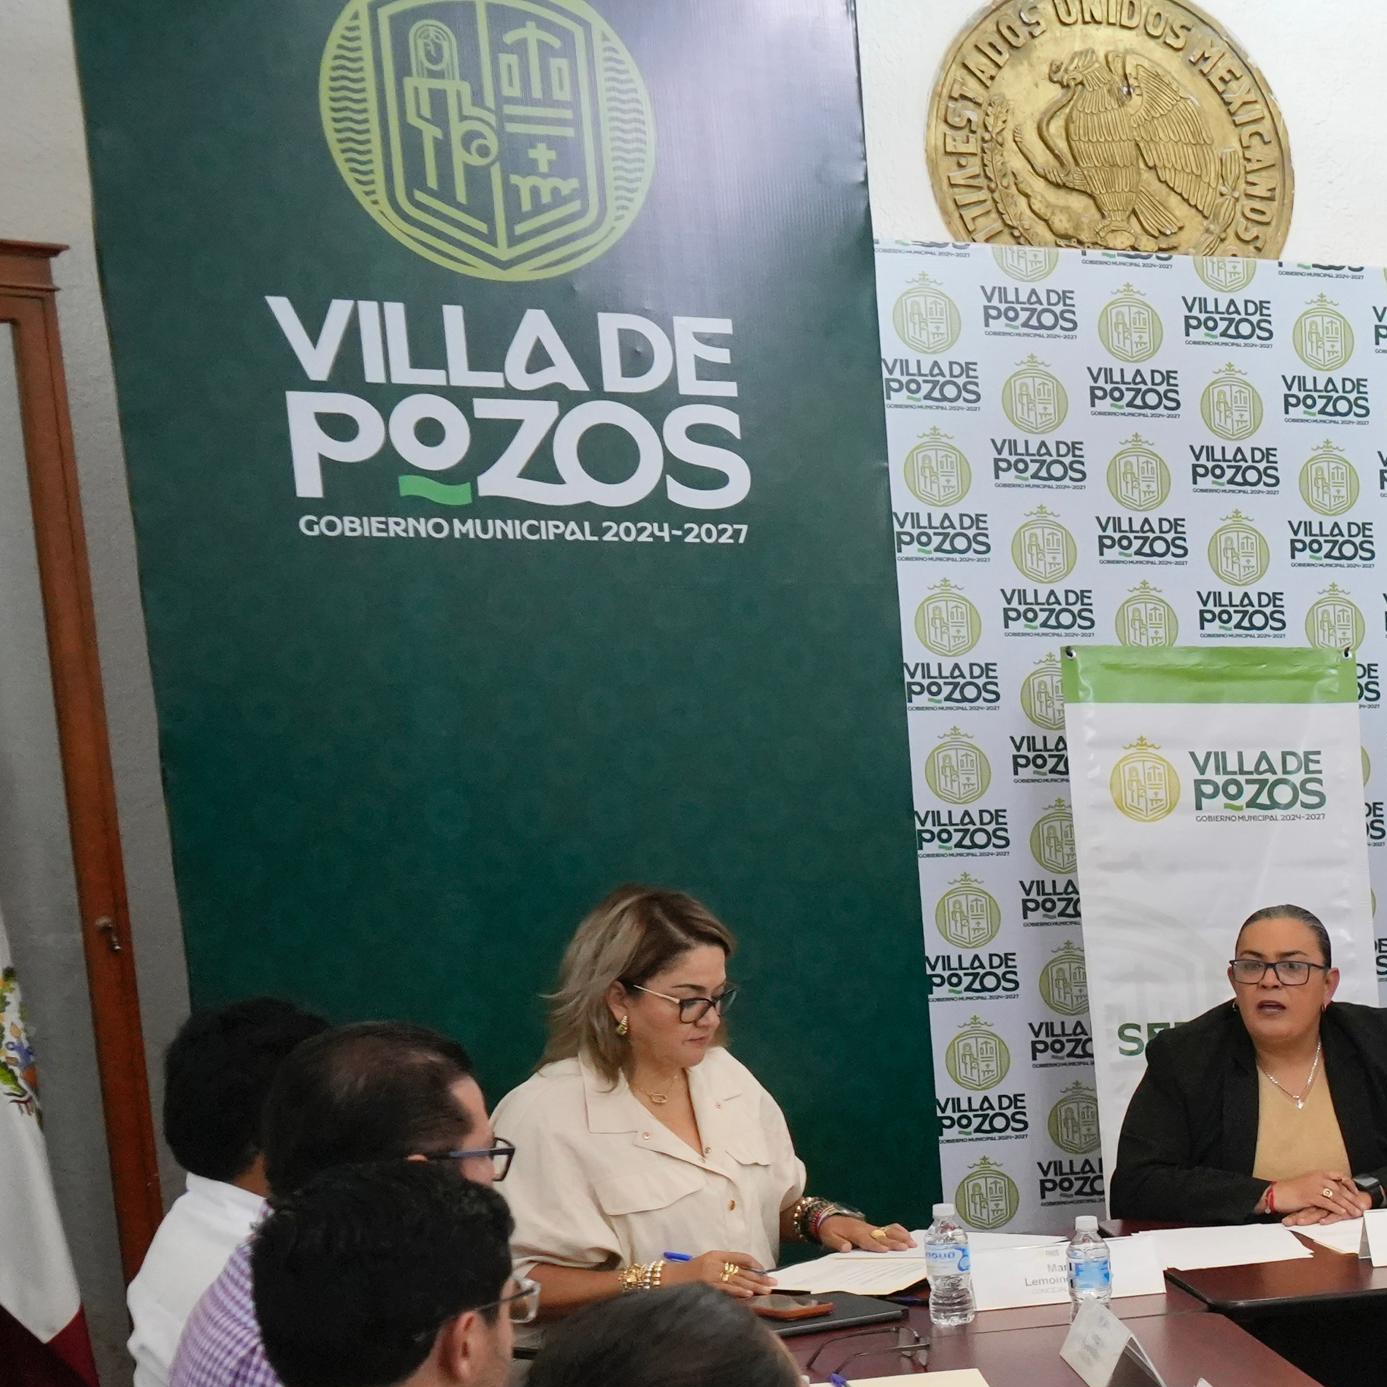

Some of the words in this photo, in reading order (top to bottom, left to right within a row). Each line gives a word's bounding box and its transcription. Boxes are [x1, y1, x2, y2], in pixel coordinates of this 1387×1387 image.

[943, 4, 1048, 156] ESTADOS
[1055, 0, 1192, 50] UNIDOS
[1190, 41, 1277, 252] MEXICANOS
[981, 286, 1044, 306] VILLA
[1046, 289, 1075, 307] DE
[1182, 296, 1241, 315] VILLA
[1244, 299, 1271, 317] DE
[983, 305, 1078, 331] POZOS
[1184, 315, 1273, 340] POZOS
[265, 296, 590, 391] VILLA
[597, 311, 739, 397] DE
[882, 358, 946, 378] VILLA
[948, 361, 978, 379] DE
[1087, 367, 1148, 386] VILLA
[1150, 369, 1178, 387] DE
[884, 378, 981, 403] POZOS
[1282, 375, 1339, 393] VILLA
[1341, 377, 1368, 394] DE
[1089, 386, 1181, 411] POZOS
[1283, 393, 1370, 417] POZOS
[285, 391, 752, 510] POZOS
[991, 438, 1053, 457] VILLA
[1055, 440, 1084, 458] DE
[1189, 445, 1248, 463] VILLA
[1250, 447, 1277, 464] DE
[993, 458, 1087, 482] POZOS
[1191, 463, 1280, 487] POZOS
[298, 514, 449, 537] GOBIERNO
[452, 518, 599, 540] MUNICIPAL
[601, 521, 749, 544] 2024-2027
[893, 512, 957, 530] VILLA
[959, 513, 988, 530] DE
[1096, 516, 1156, 534] VILLA
[1158, 517, 1186, 534] DE
[1288, 520, 1345, 537] VILLA
[1347, 522, 1373, 538] DE
[895, 531, 991, 554] POZOS
[1098, 535, 1188, 558] POZOS
[1290, 538, 1375, 561] POZOS
[1000, 589, 1062, 606] VILLA
[1064, 589, 1092, 606] DE
[1197, 591, 1255, 608] VILLA
[1257, 592, 1284, 608] DE
[1003, 607, 1095, 629] POZOS
[1199, 609, 1286, 631] POZOS
[904, 662, 967, 679] VILLA
[969, 662, 998, 679] DE
[906, 681, 1000, 703] POZOS
[1009, 735, 1067, 753] VILLA
[1012, 754, 1069, 776] POZ
[1189, 751, 1278, 776] VILLA
[1281, 750, 1322, 775] DE
[1193, 777, 1326, 810] POZOS
[914, 810, 976, 827] VILLA
[978, 809, 1007, 825] DE
[1281, 813, 1324, 821] 2024-2027
[916, 827, 1010, 850] POZOS
[1019, 879, 1079, 896] VILLA
[926, 954, 986, 971] VILLA
[988, 952, 1017, 969] DE
[928, 970, 1019, 994] POZOS
[1028, 1021, 1088, 1038] VILLA
[936, 1095, 996, 1114] VILLA
[997, 1093, 1026, 1110] DE
[938, 1111, 1028, 1136] POZOS
[1037, 1159, 1096, 1177] VILLA
